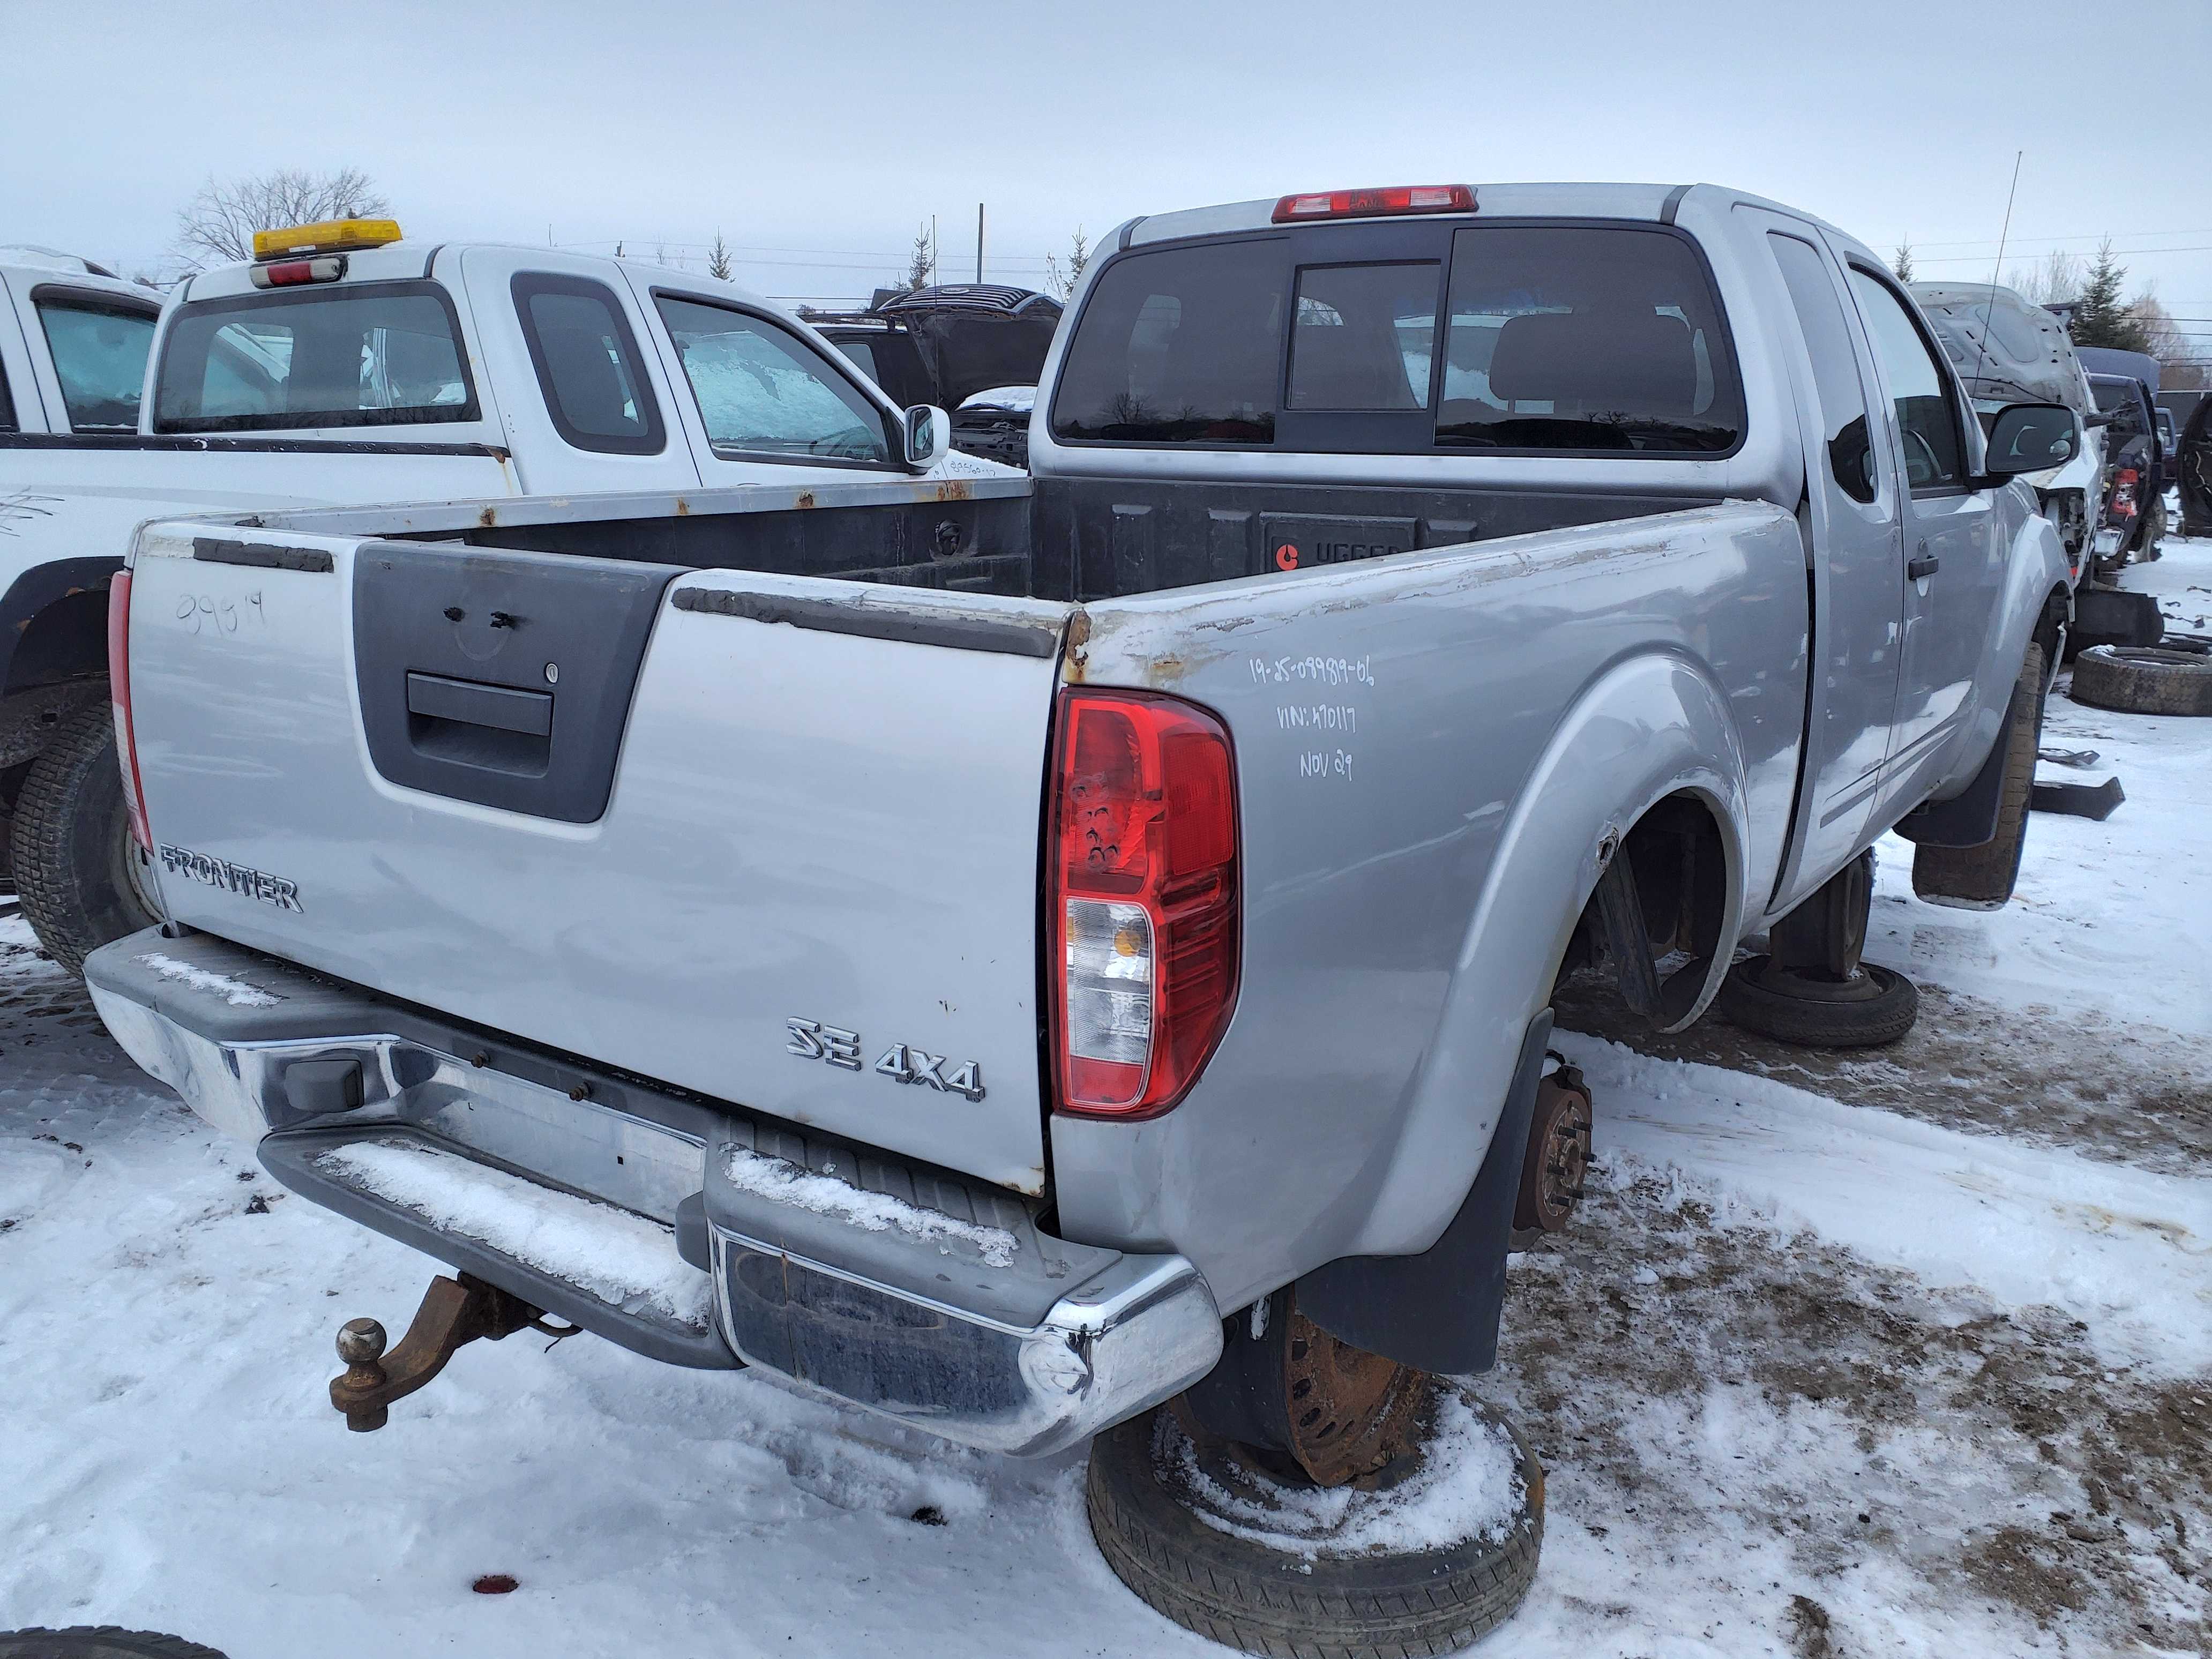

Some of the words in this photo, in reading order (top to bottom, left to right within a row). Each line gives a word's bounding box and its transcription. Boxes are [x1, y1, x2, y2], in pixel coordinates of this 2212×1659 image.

[1276, 705, 1310, 729] VIN:
[1299, 750, 1329, 778] NOV
[1334, 749, 1352, 782] 29
[160, 842, 304, 914] FRONTIER
[786, 1016, 862, 1072] SE
[875, 1042, 986, 1103] 4X4
